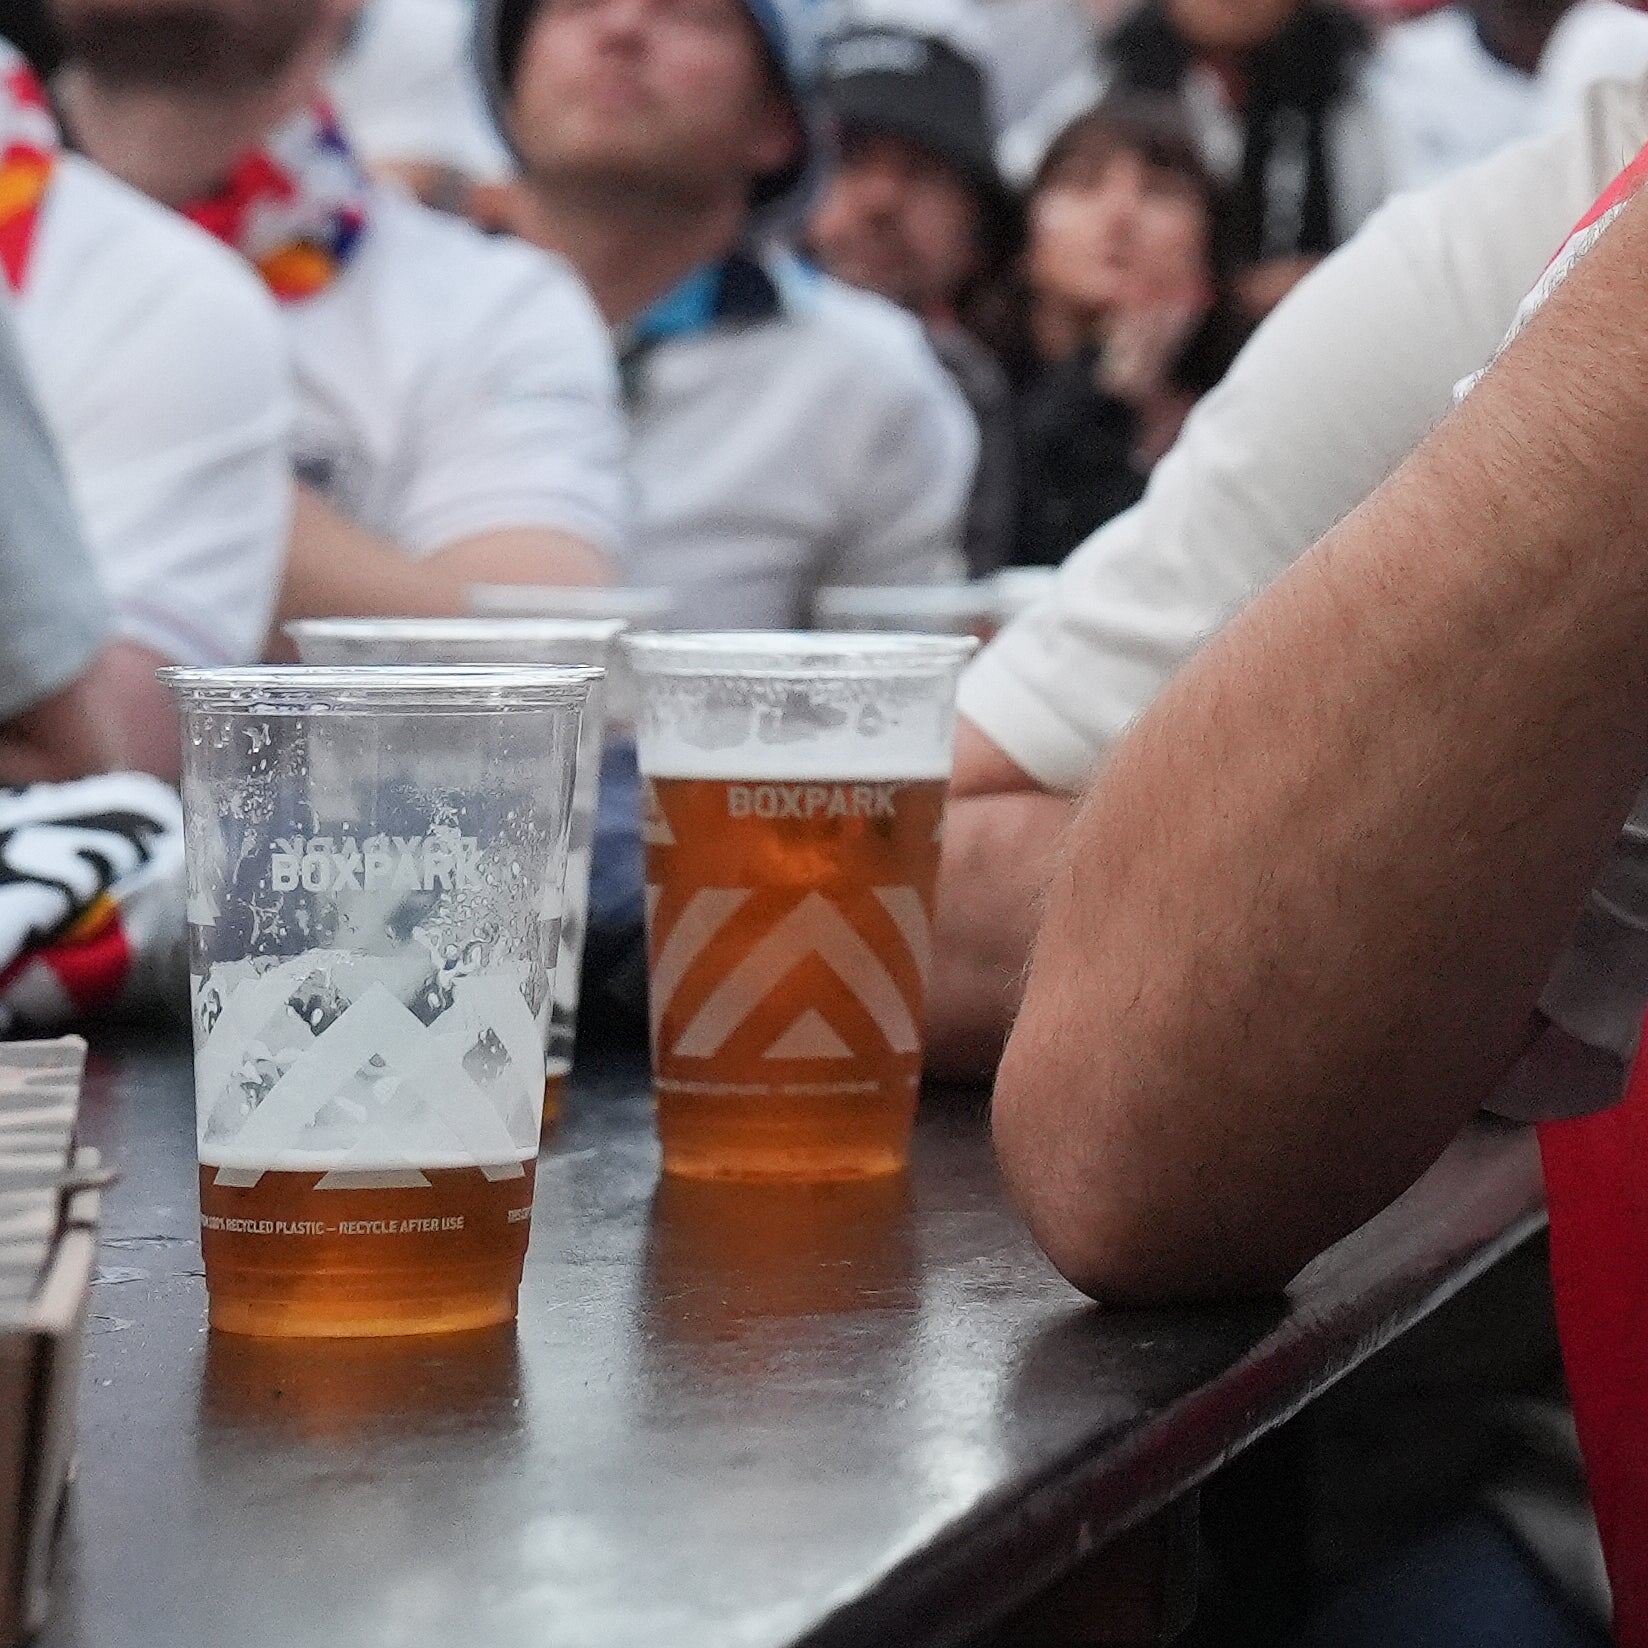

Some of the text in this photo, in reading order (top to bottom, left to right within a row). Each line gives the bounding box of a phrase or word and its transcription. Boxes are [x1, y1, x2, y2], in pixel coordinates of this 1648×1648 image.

[728, 784, 897, 818] BOXPARK
[272, 852, 482, 892] BOXPARK
[226, 1218, 274, 1234] RECYCLED
[275, 1220, 324, 1235] PLASTIC
[339, 1220, 398, 1235] RECYCLE
[400, 1218, 439, 1233] AFTER
[441, 1215, 464, 1231] USE
